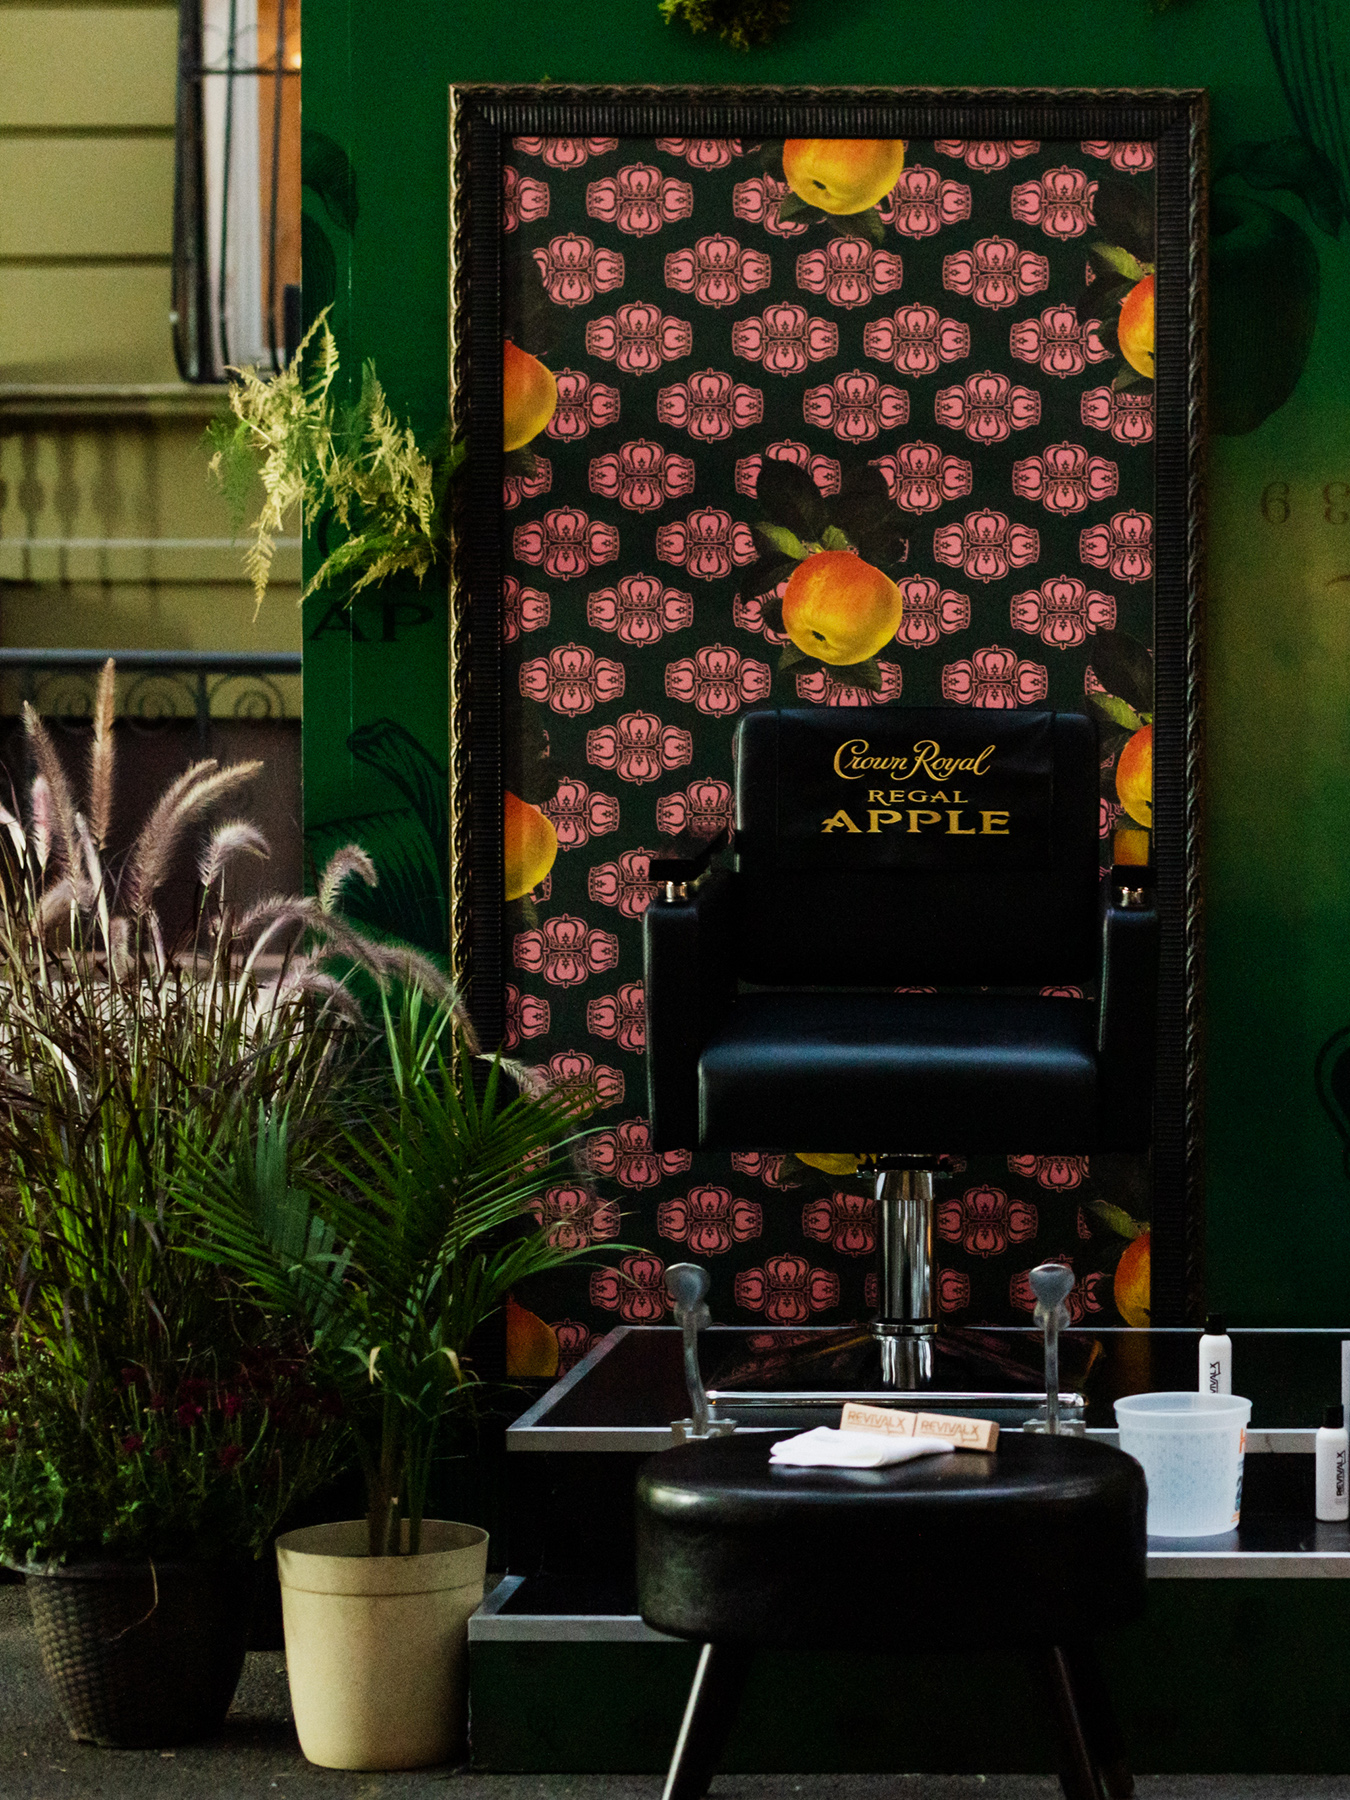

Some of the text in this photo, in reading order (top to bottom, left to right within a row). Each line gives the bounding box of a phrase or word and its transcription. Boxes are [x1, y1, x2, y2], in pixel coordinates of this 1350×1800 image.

[834, 739, 996, 782] Crown Royal
[867, 790, 968, 806] REGAL
[821, 809, 1010, 835] APPLE
[1210, 1361, 1221, 1393] VIVALX
